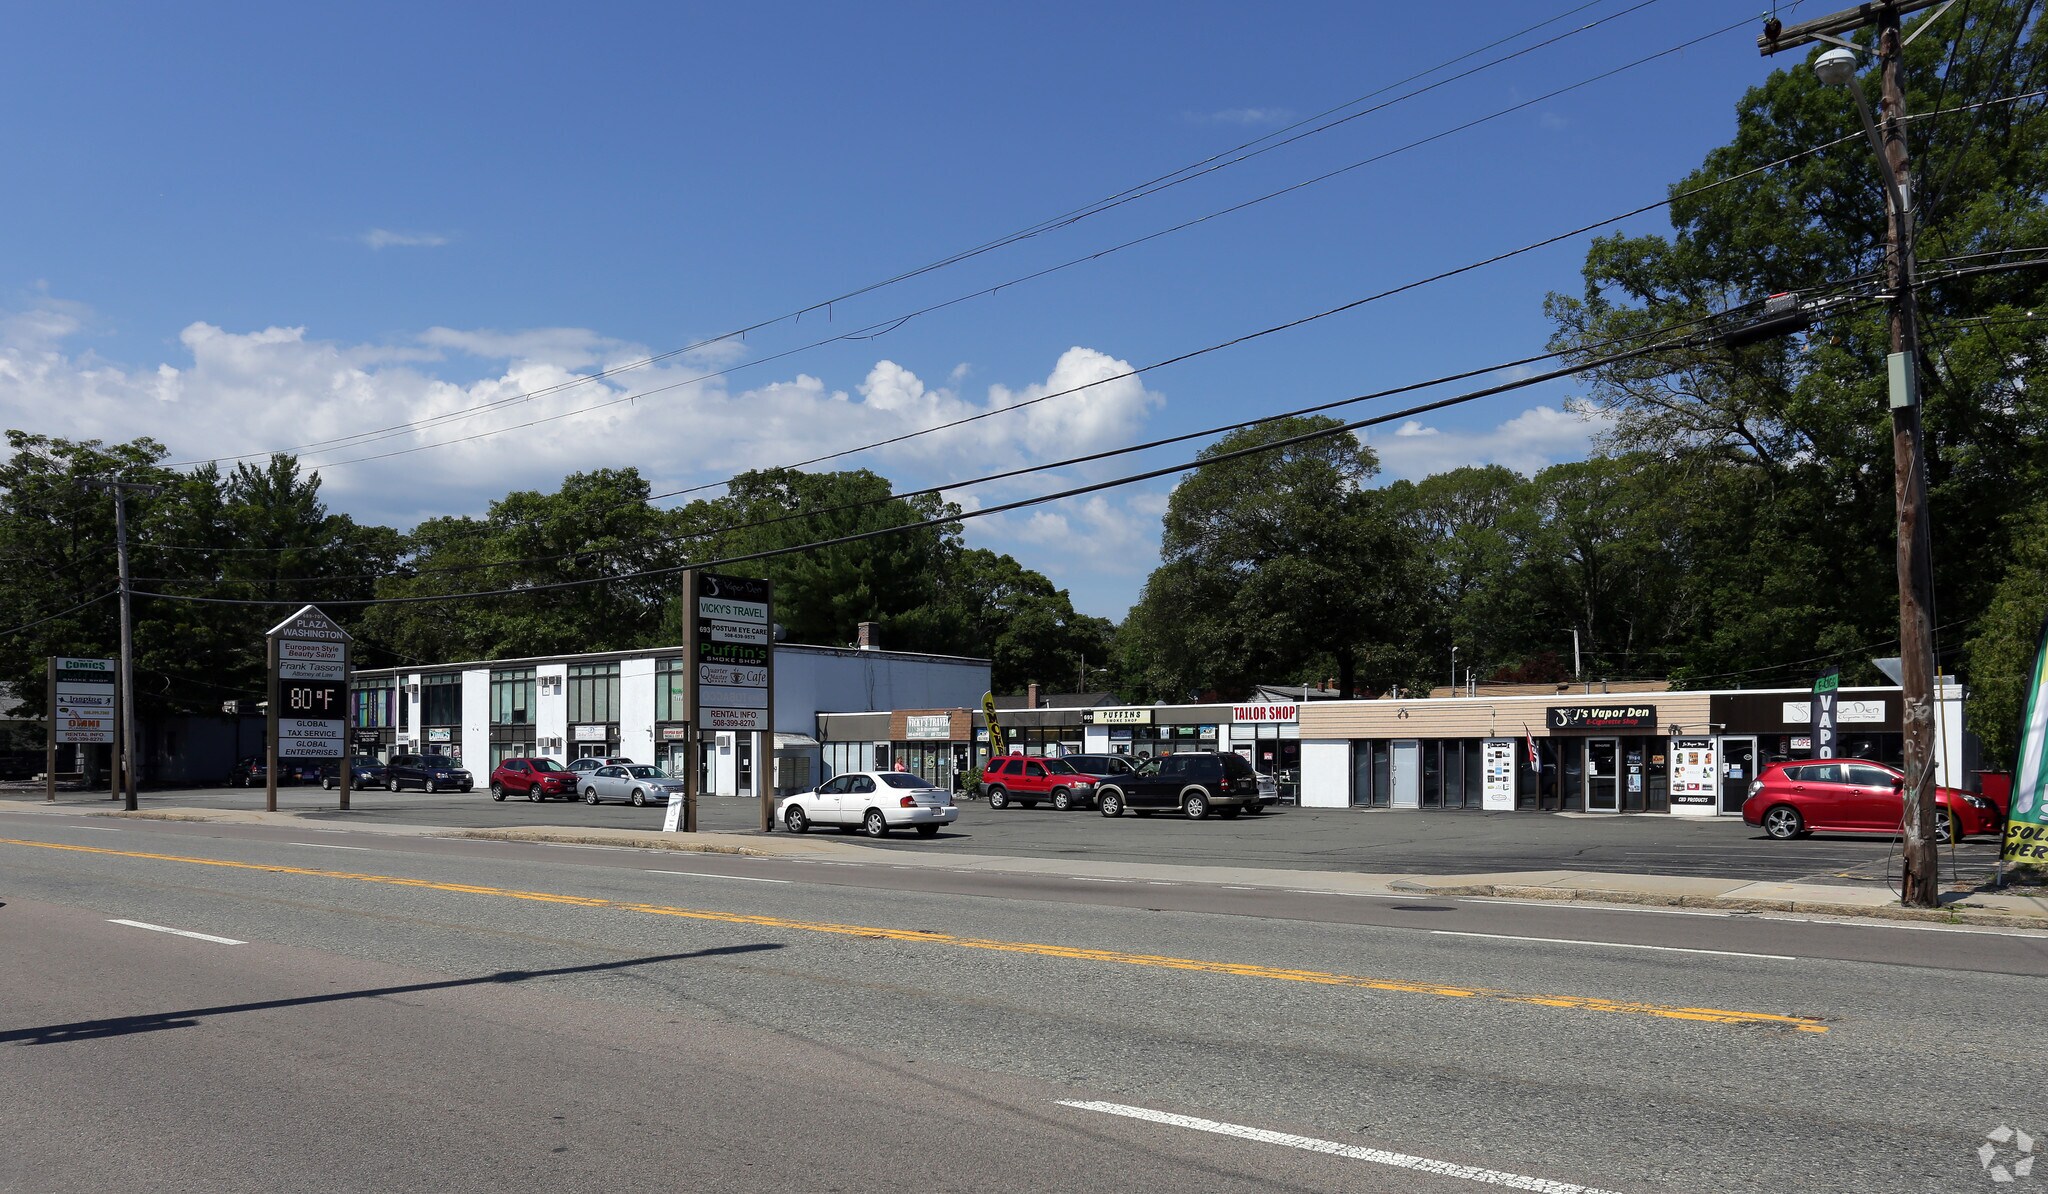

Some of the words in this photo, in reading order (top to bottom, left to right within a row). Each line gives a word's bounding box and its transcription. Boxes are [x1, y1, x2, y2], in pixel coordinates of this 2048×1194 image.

[701, 602, 731, 615] VICKY'S
[732, 606, 765, 618] TRAVEL
[297, 620, 328, 629] PLAZA
[283, 628, 343, 640] WASHINGTON
[285, 643, 320, 652] European
[322, 645, 339, 653] Style
[700, 643, 767, 659] Puffin's
[288, 650, 314, 659] Beauty
[316, 651, 336, 659] Salon
[65, 660, 106, 670] COMICS
[280, 662, 307, 671] Frank
[309, 663, 344, 672] Tassoni
[746, 670, 767, 685] Cafe
[1853, 702, 1880, 713] Den
[1234, 706, 1266, 720] TAILOR
[1269, 706, 1295, 720] SHOP
[1573, 708, 1589, 720] J's
[1591, 708, 1625, 720] Vapor
[1627, 707, 1649, 717] Den
[296, 720, 328, 728] GLOBAL
[712, 719, 756, 727] 508-399-8270
[296, 740, 328, 748] GLOBAL
[1798, 738, 1810, 747] OPE
[285, 748, 338, 756] ENTERPRISES
[2007, 825, 2048, 842] SOL
